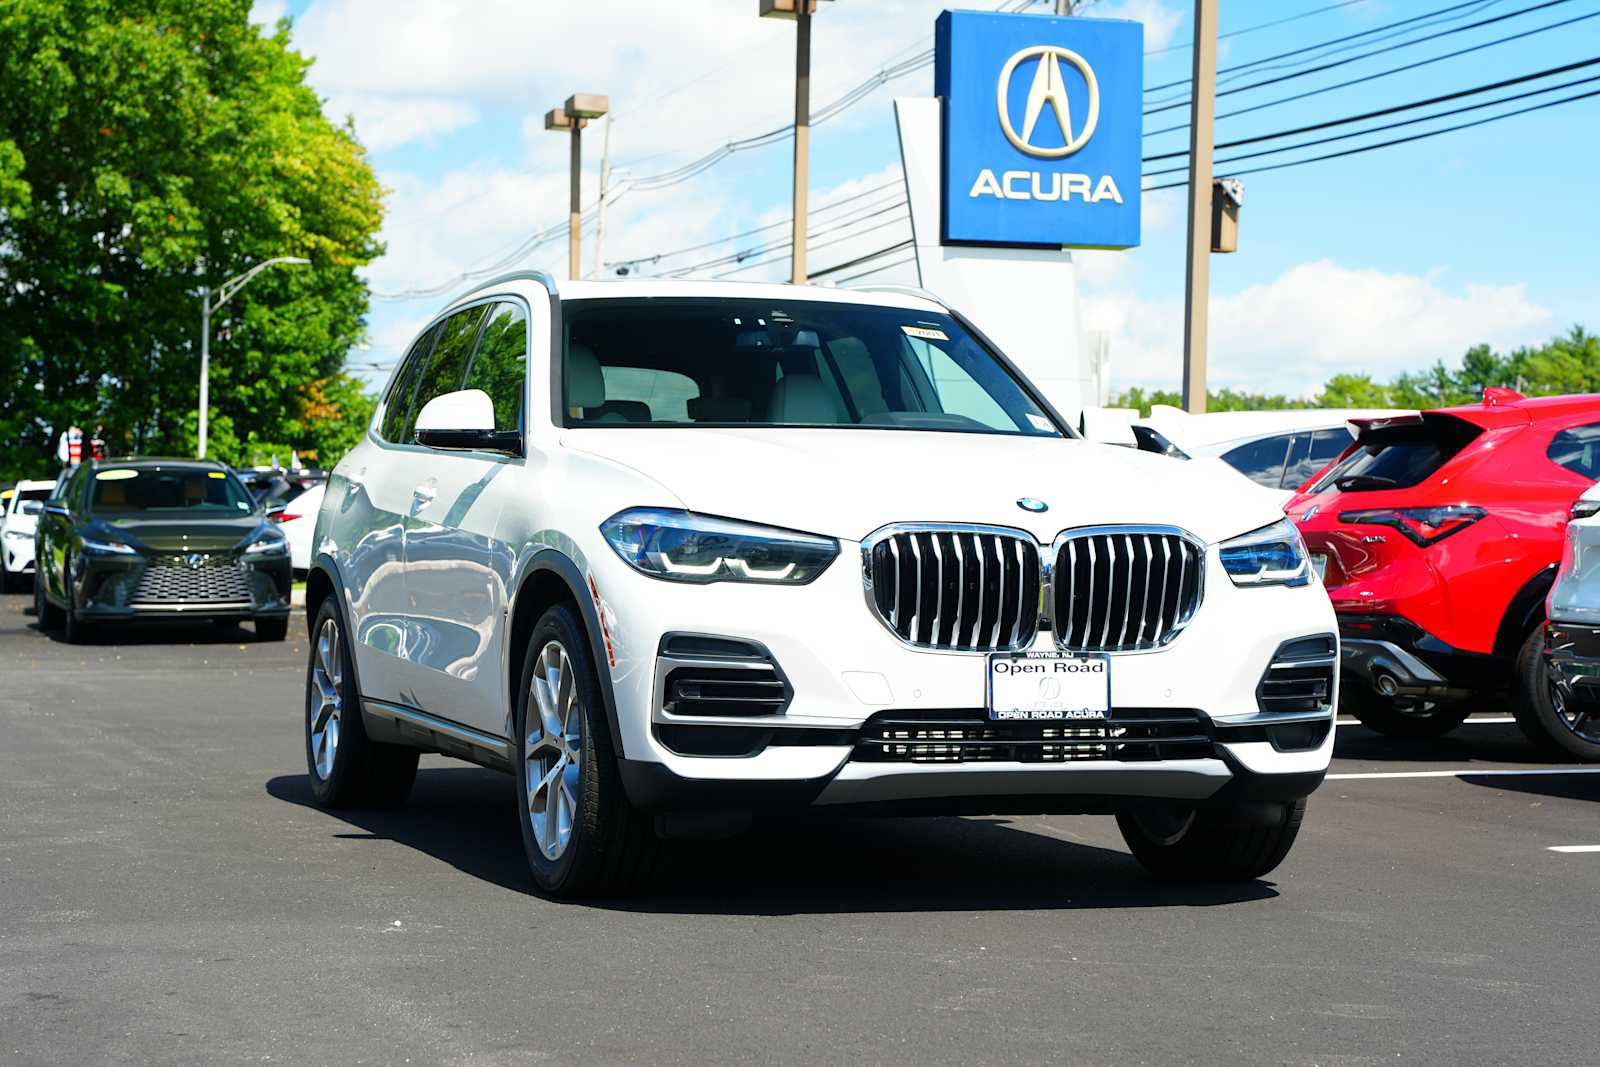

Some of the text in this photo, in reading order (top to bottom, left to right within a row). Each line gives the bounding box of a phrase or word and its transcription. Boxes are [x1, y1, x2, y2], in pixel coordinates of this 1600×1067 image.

[969, 168, 1123, 204] ACURA
[994, 662, 1104, 676] Open Road
[998, 711, 1105, 719] OPEN ROAD ACURA
